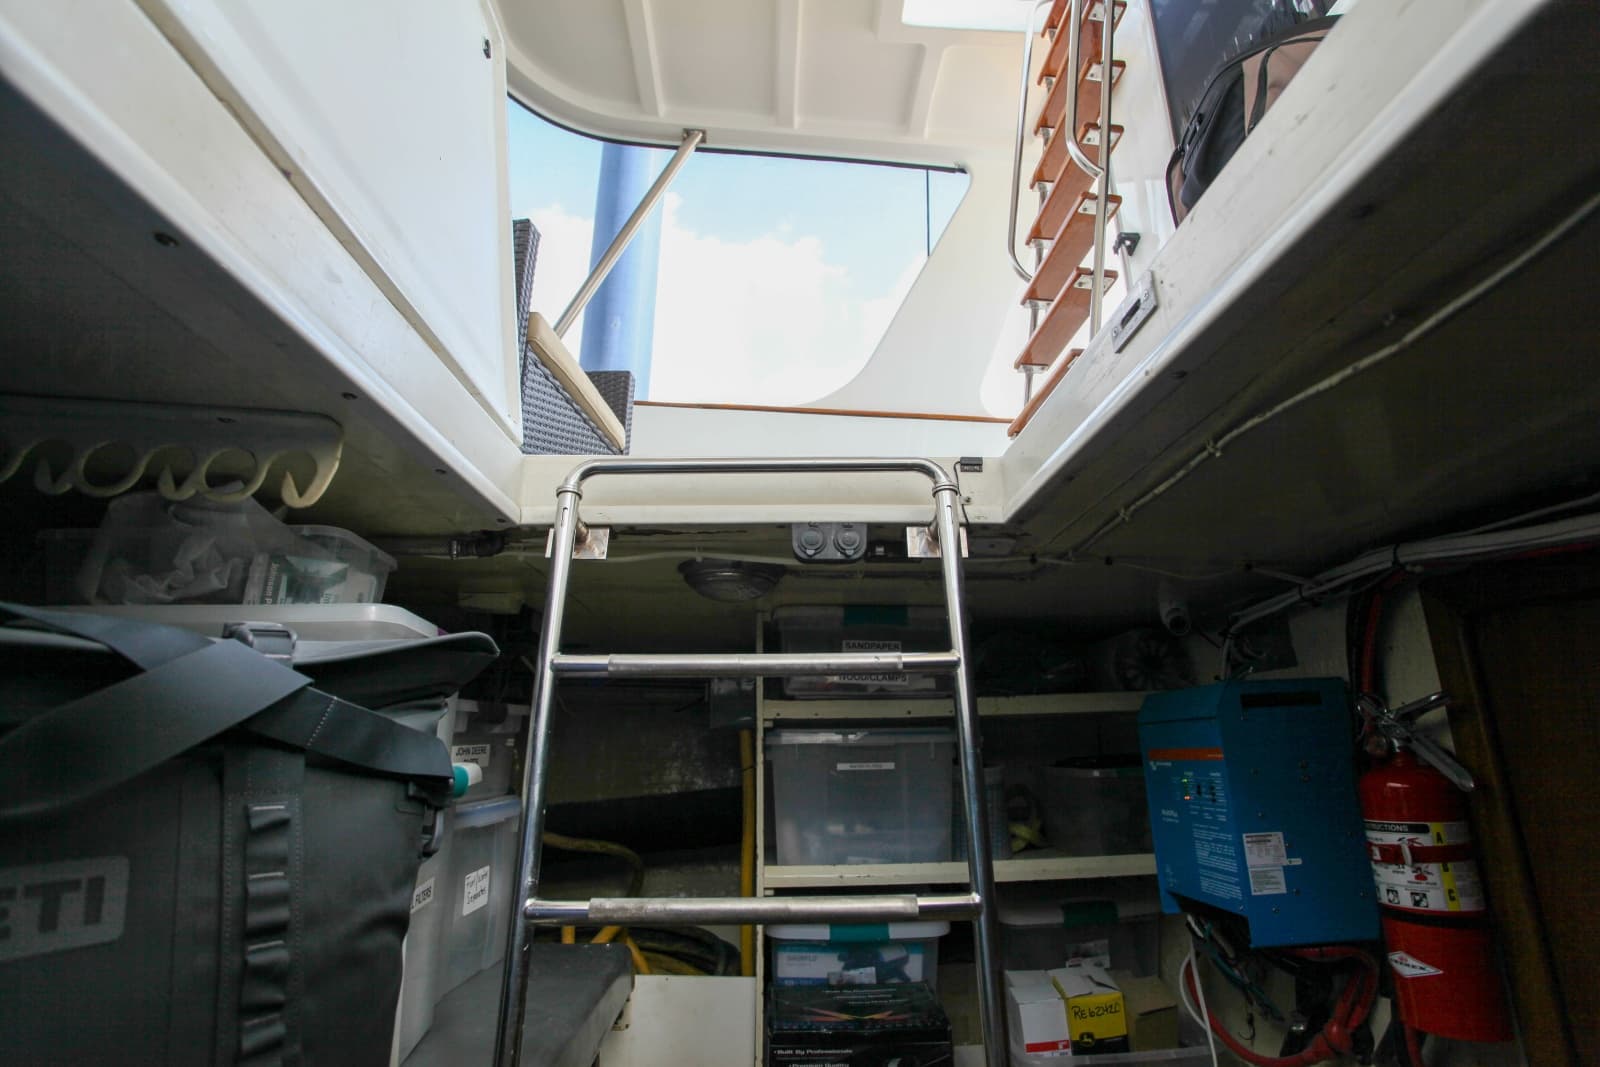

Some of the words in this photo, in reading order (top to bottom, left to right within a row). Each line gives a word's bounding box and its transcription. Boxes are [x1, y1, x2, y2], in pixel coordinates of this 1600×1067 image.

[846, 641, 900, 650] SANDPAPER
[456, 747, 470, 756] JOHN
[471, 746, 487, 755] DEERE
[415, 886, 432, 905] FILTERS
